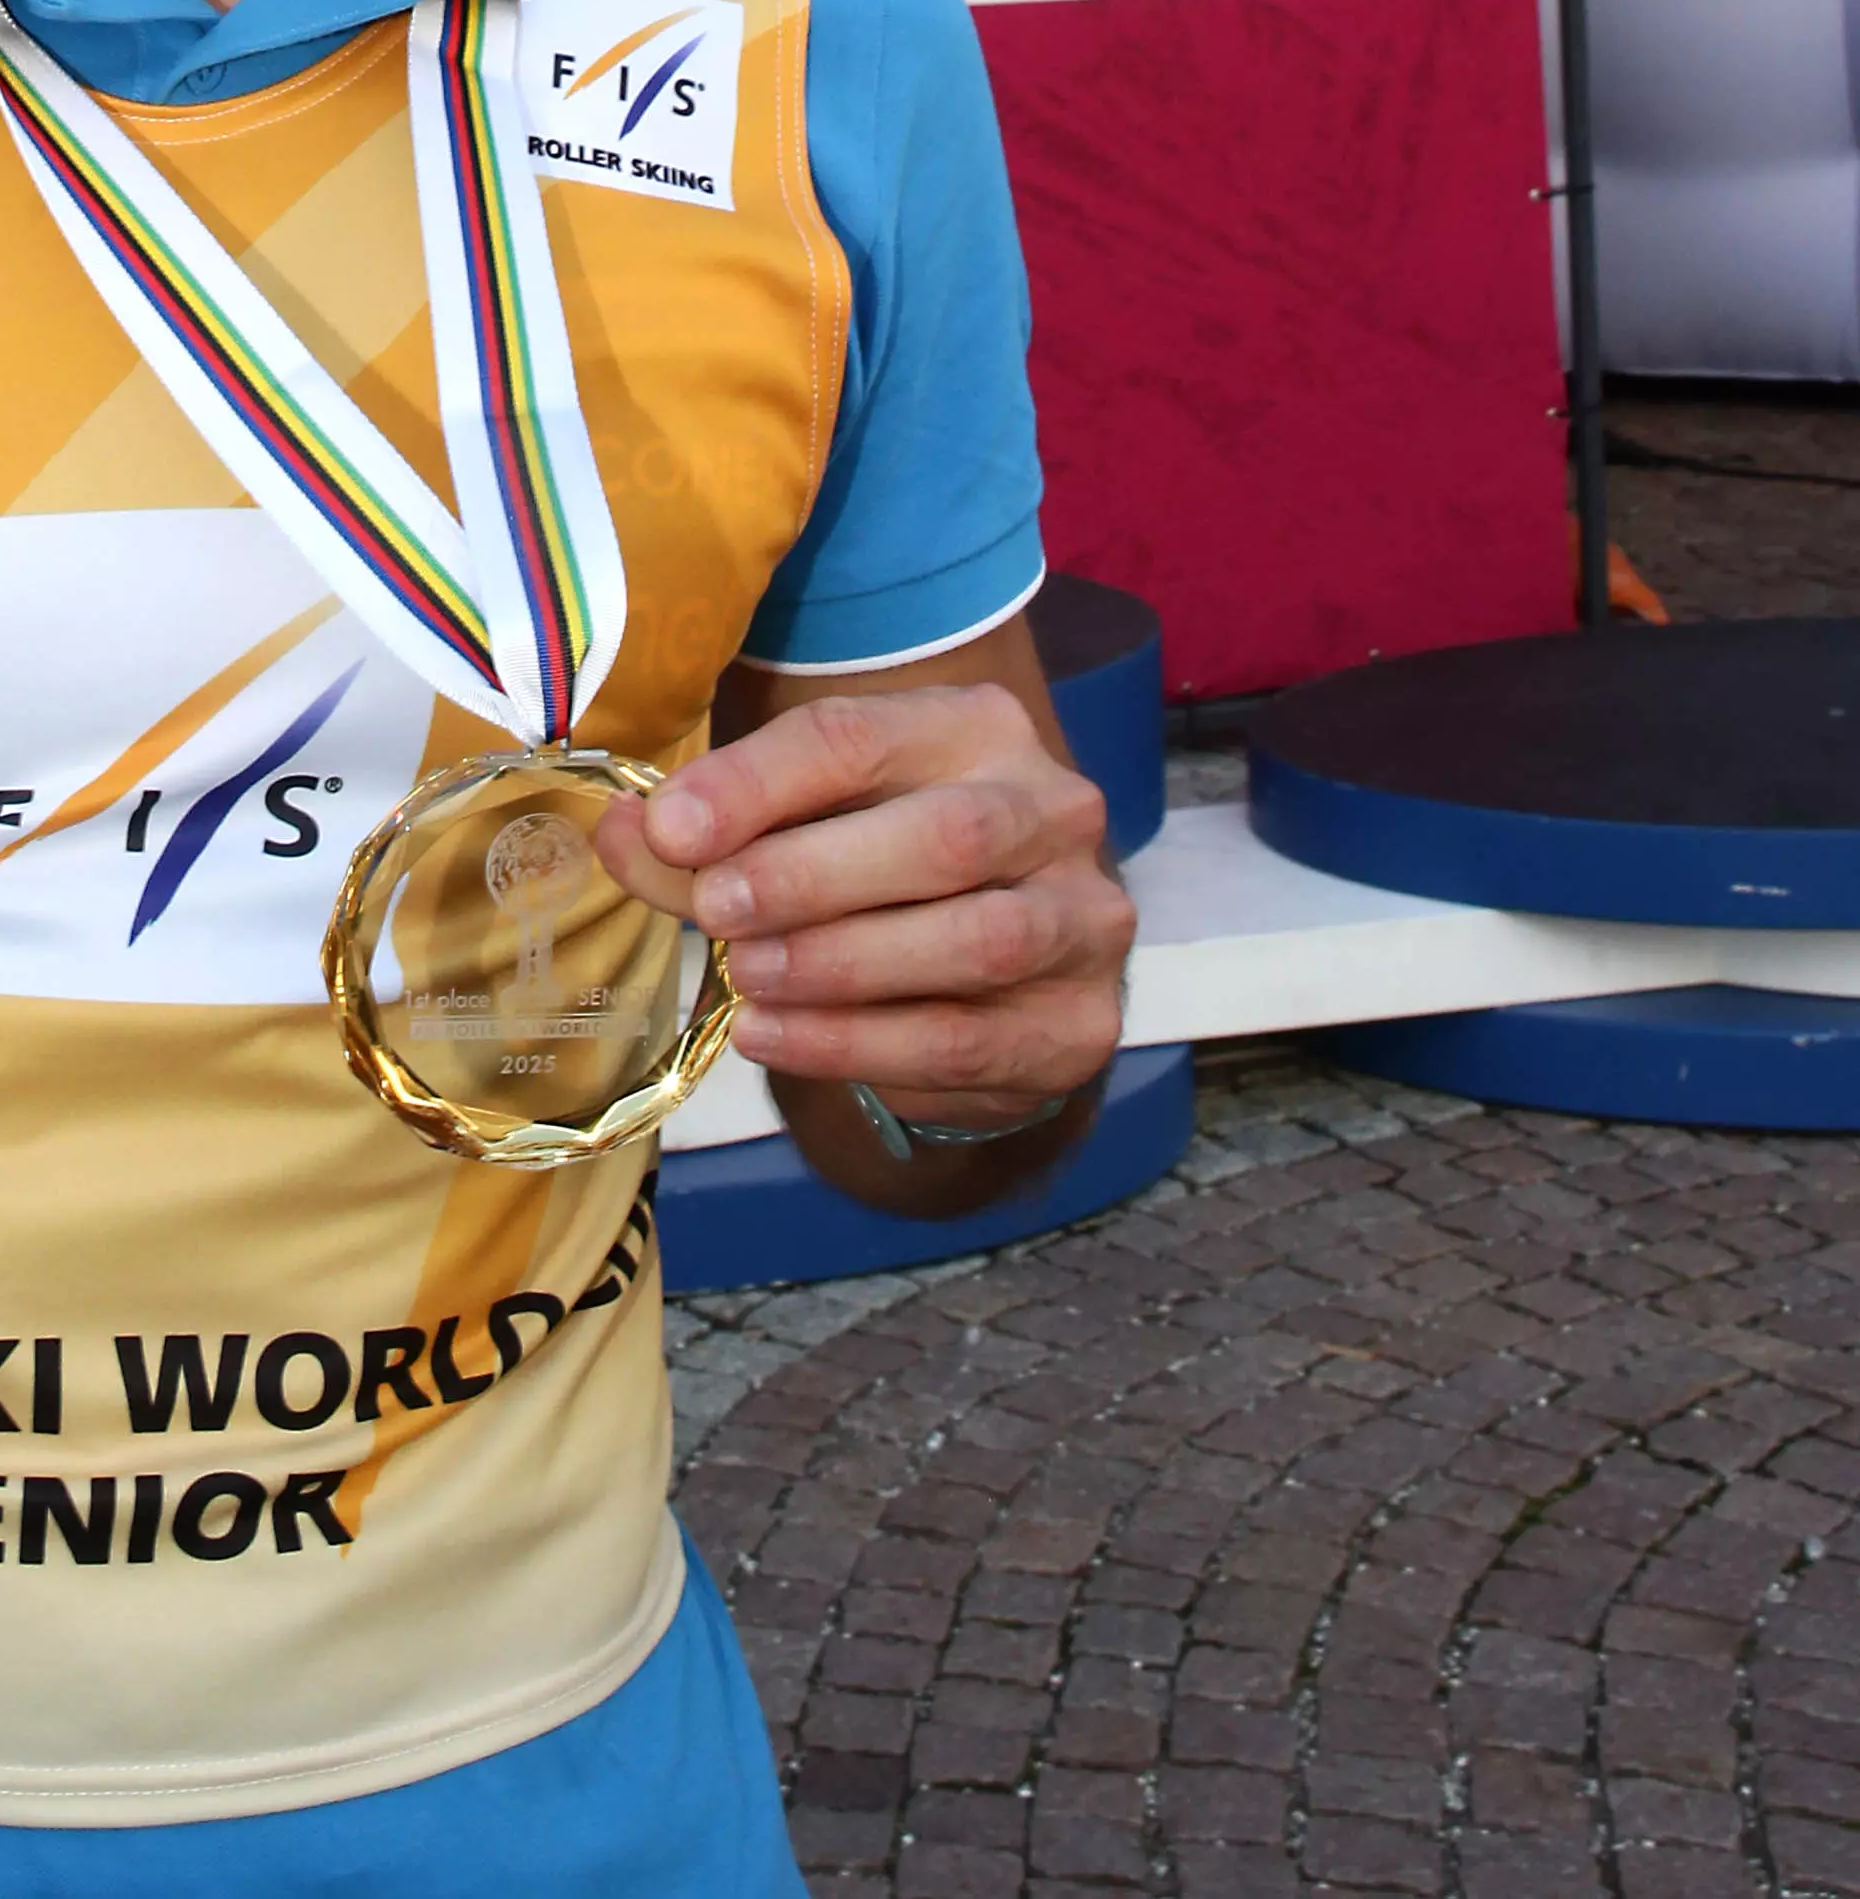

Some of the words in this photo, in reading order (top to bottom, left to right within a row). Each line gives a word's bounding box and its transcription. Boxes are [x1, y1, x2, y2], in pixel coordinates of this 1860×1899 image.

[527, 135, 622, 172] ROLLER
[630, 157, 715, 195] SKIING
[438, 987, 492, 1012] place
[500, 1054, 557, 1075] 2025
